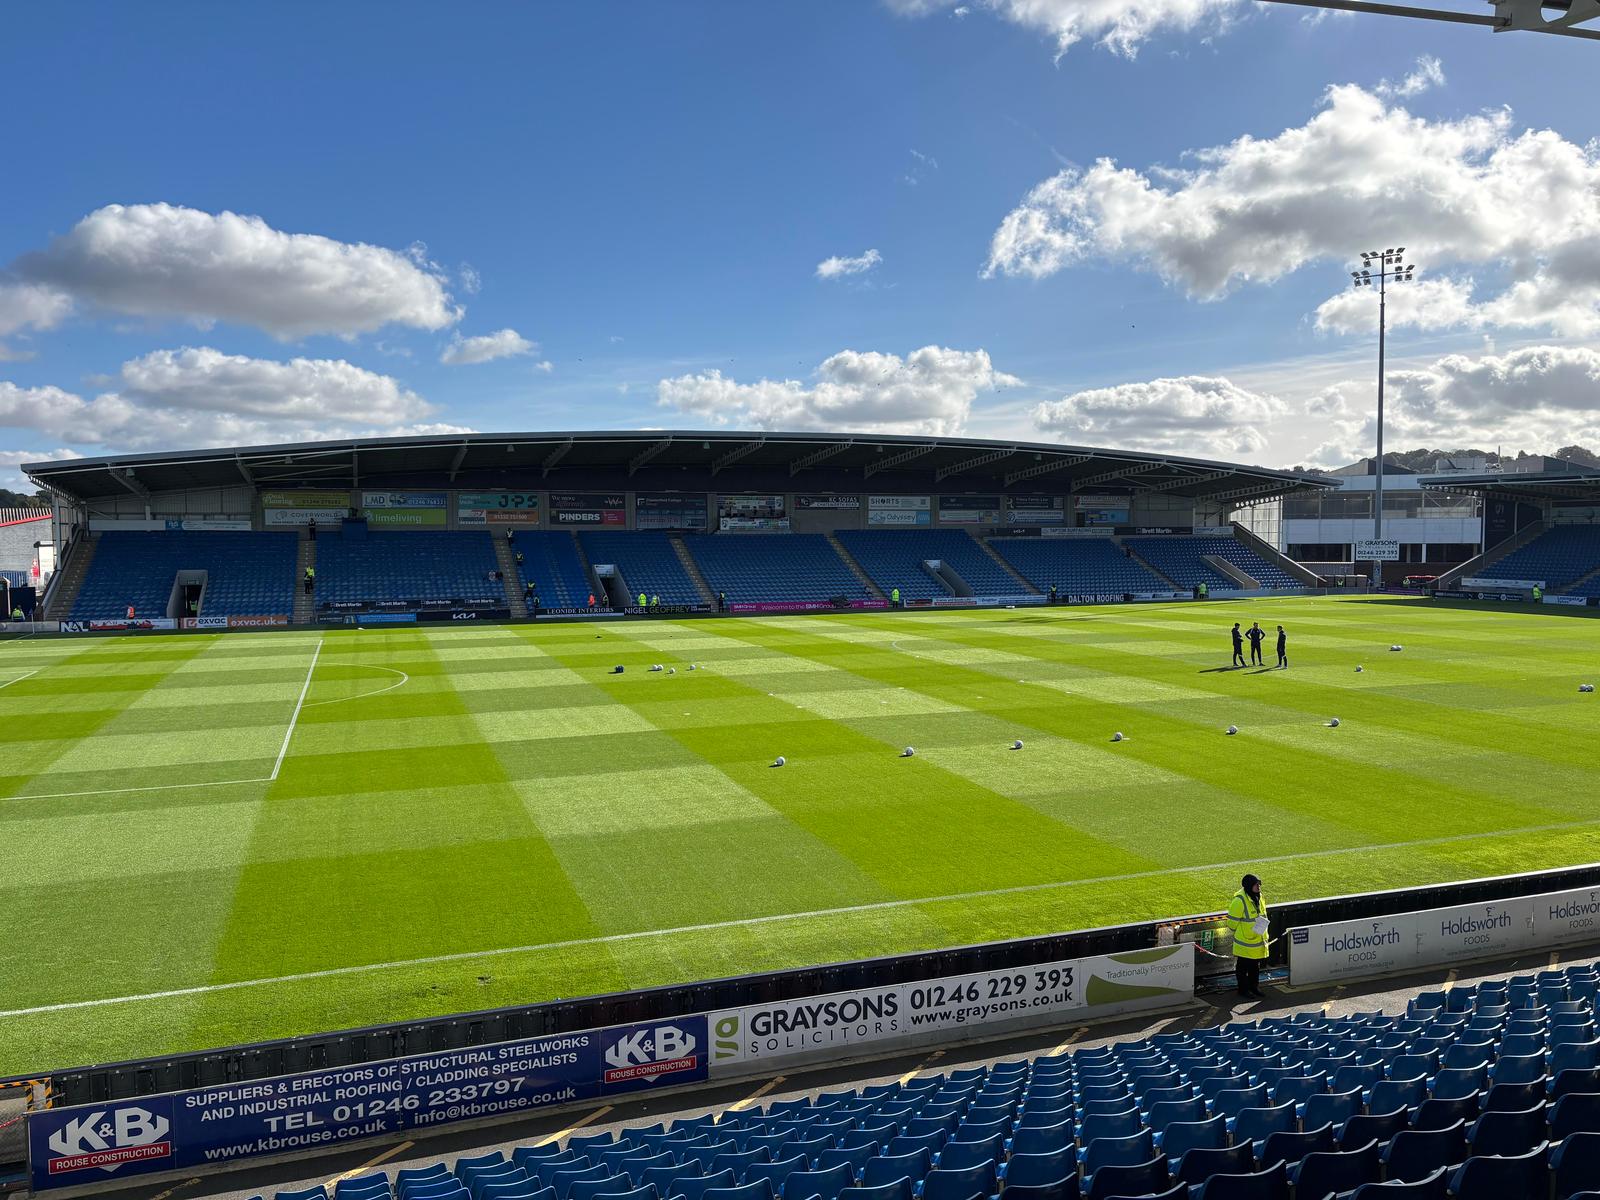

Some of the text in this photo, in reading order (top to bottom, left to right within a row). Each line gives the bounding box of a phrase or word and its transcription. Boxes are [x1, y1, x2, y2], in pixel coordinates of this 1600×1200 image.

[365, 496, 385, 504] LMD
[499, 495, 538, 508] JPS
[375, 514, 422, 524] limeliving
[560, 513, 601, 521] PINDERS
[1068, 594, 1124, 603] DALTON ROOFING
[61, 622, 89, 632] NAL
[231, 617, 277, 626] exvac.uk
[1441, 911, 1511, 936] Holdsworth
[1569, 918, 1593, 928] FOODS
[1324, 928, 1400, 952] Holdsworth
[1464, 934, 1490, 945] FOODS
[1348, 951, 1377, 962] FOODS
[1106, 962, 1190, 979] Traditionally Progressive
[910, 967, 1074, 1010] 01246 229 393
[750, 992, 898, 1036] GRAYSONS
[910, 989, 1073, 1025] www.graysons.co.uk
[751, 1019, 898, 1053] SOLICITORS
[185, 1036, 590, 1108] SUPPLIERS & ERECTORS OF STRUCTURAL STEELWORKS
[610, 1060, 691, 1079] ROUSE CONSTRUCTION
[201, 1107, 234, 1123] AND
[239, 1092, 331, 1117] INDUSTRIAL
[335, 1080, 403, 1102] ROOFING
[415, 1067, 488, 1088] CLADDING
[492, 1052, 578, 1075] SPECIALISTS
[263, 1077, 526, 1133] TEL 01246 233797
[205, 1087, 576, 1160] www.kbrouse.co.uk info@kbrouse.co.uk
[56, 1146, 164, 1169] ROUSE CONSTRUCTION
